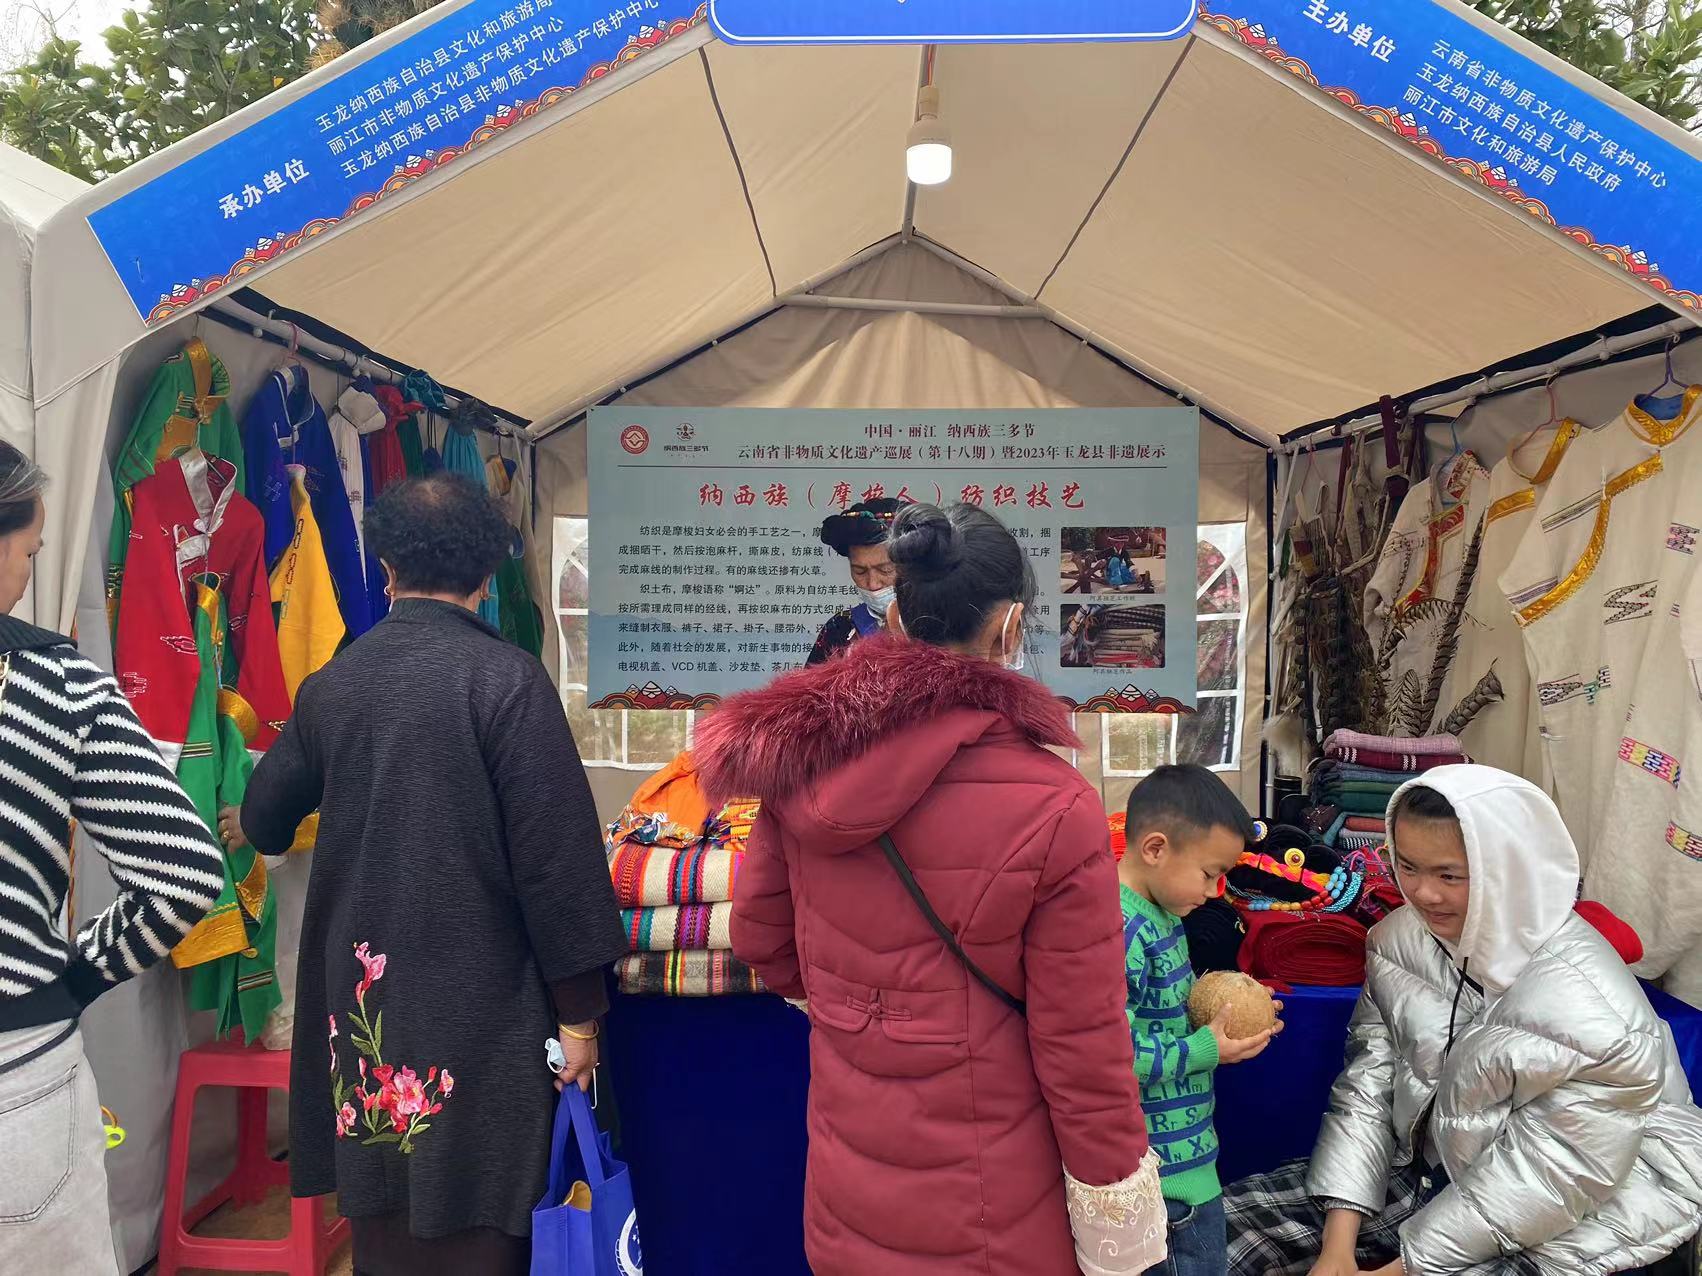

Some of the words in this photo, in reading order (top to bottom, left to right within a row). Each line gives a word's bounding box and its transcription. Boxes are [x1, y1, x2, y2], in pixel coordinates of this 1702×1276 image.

[316, 0, 552, 132] 玉龙纳西族自治县文化和旅游局
[327, 16, 564, 155] 丽江市非物质文化遗产保护中心
[342, 0, 660, 178] 玉龙纳西族自治县非物质文化遗产保护中心
[1302, 0, 1397, 63] 主办单位
[1402, 83, 1558, 186] 丽江市文化和旅游局
[1416, 61, 1622, 192] 玉龙纳西族自治县人民政府
[1432, 39, 1668, 189] 云南省非物质文化遗产保护中心
[219, 159, 309, 219] 承办单位
[737, 444, 1166, 460] 云南省非物质文化遗产巡展（第十八期）暨2023年玉龙县非遗展示
[947, 423, 1035, 438] 纳西族三多节
